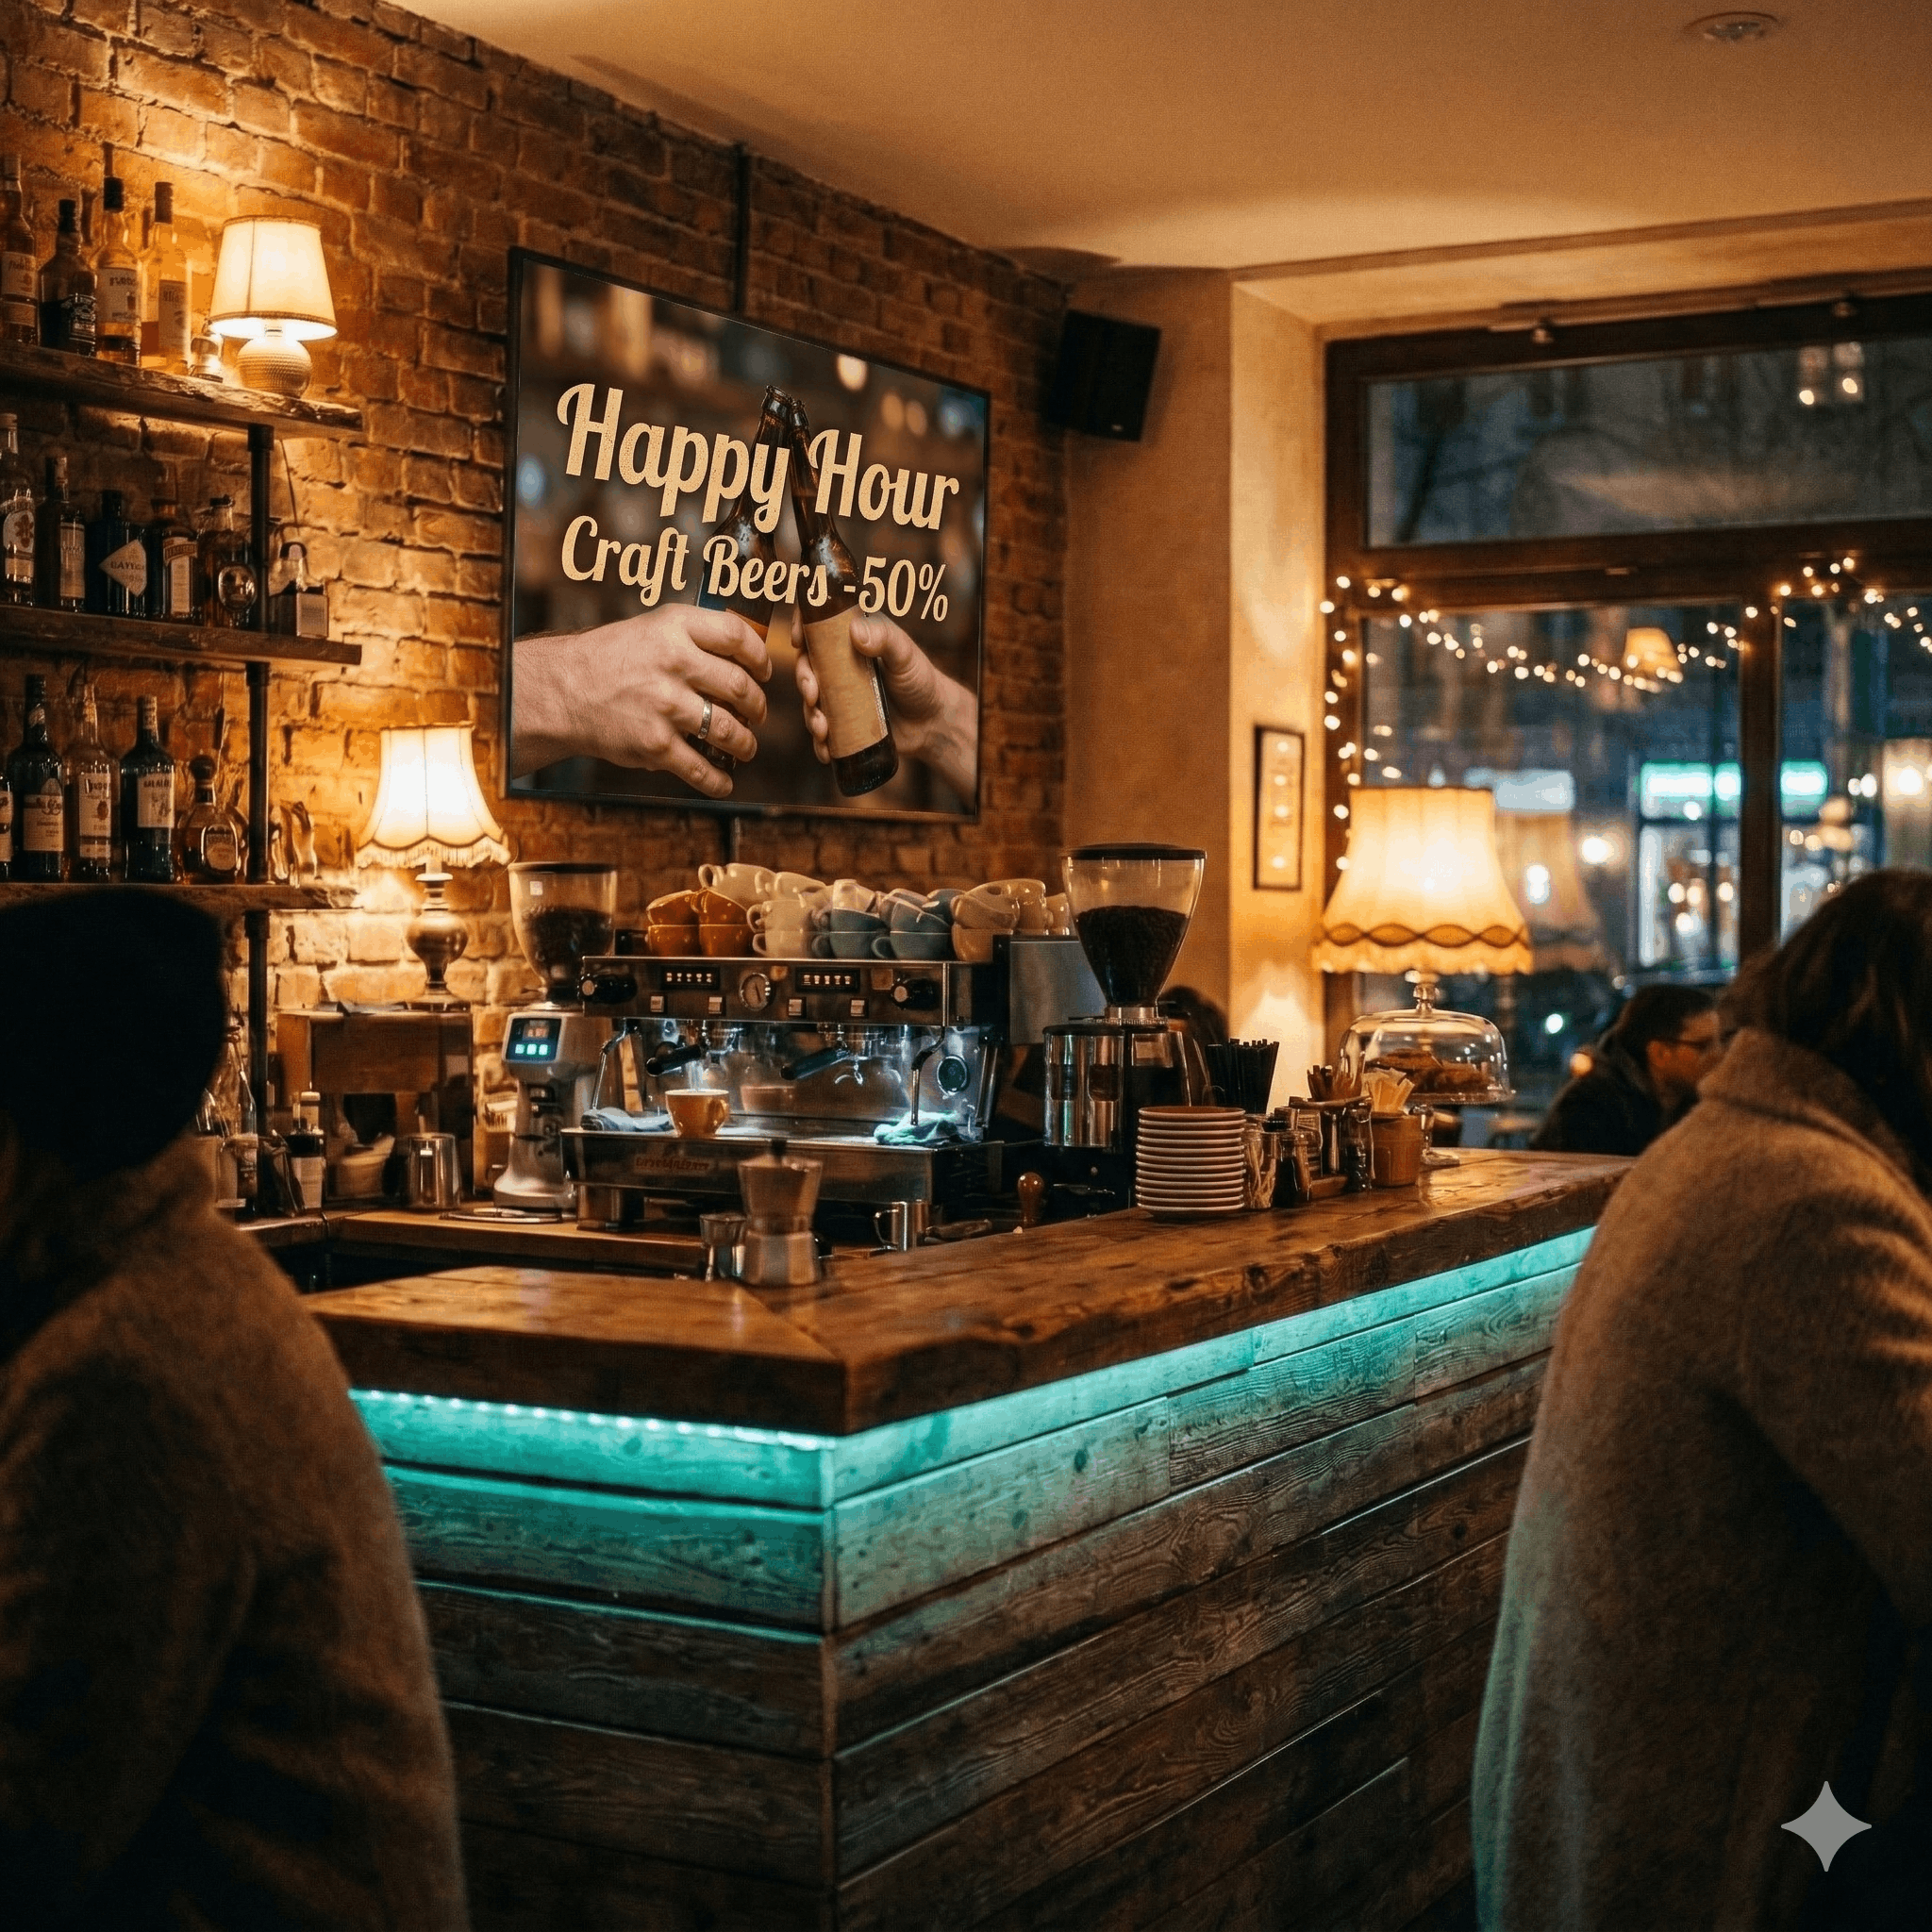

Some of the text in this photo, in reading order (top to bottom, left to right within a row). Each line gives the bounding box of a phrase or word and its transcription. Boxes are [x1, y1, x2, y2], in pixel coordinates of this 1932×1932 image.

[557, 383, 960, 534] Happy Hour
[561, 515, 949, 623] Craft Beers -50%
